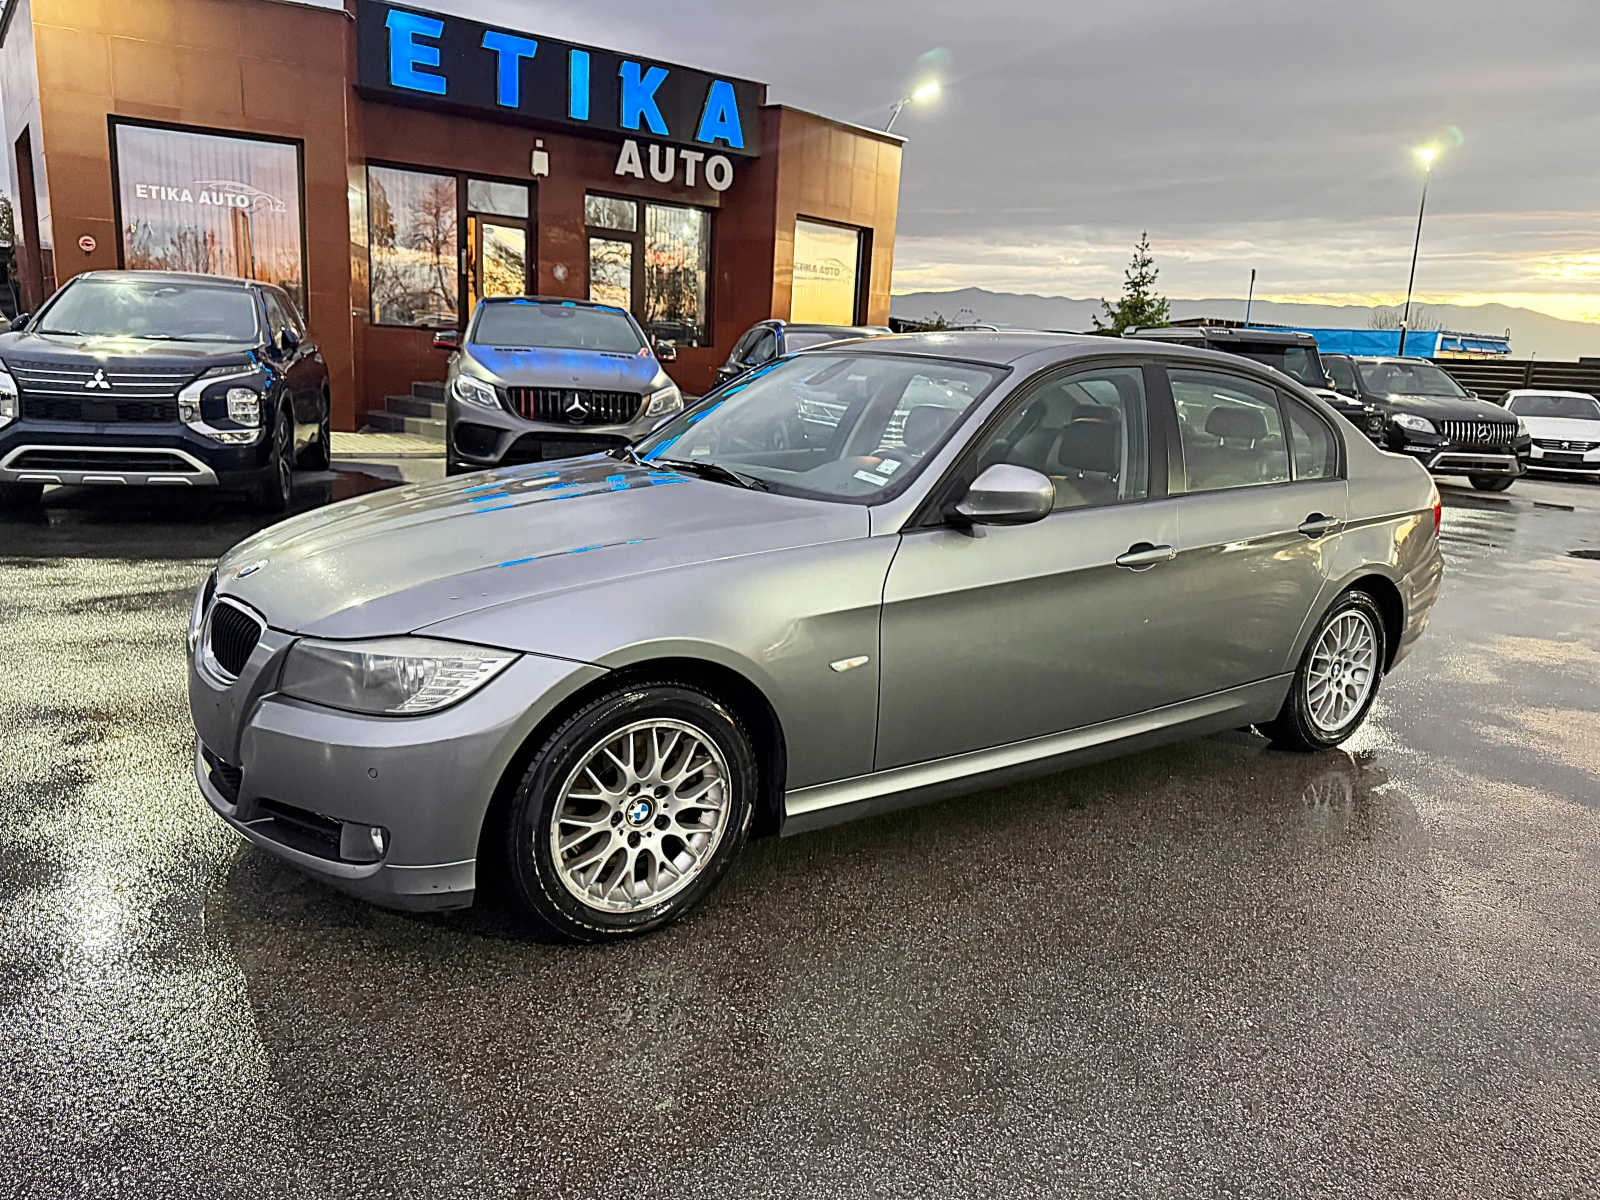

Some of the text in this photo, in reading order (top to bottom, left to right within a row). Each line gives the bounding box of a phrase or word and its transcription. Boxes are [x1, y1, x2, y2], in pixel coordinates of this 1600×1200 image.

[385, 9, 745, 149] ETIKA
[614, 139, 734, 191] AUTO
[135, 183, 250, 208] ETIKA AUTO
